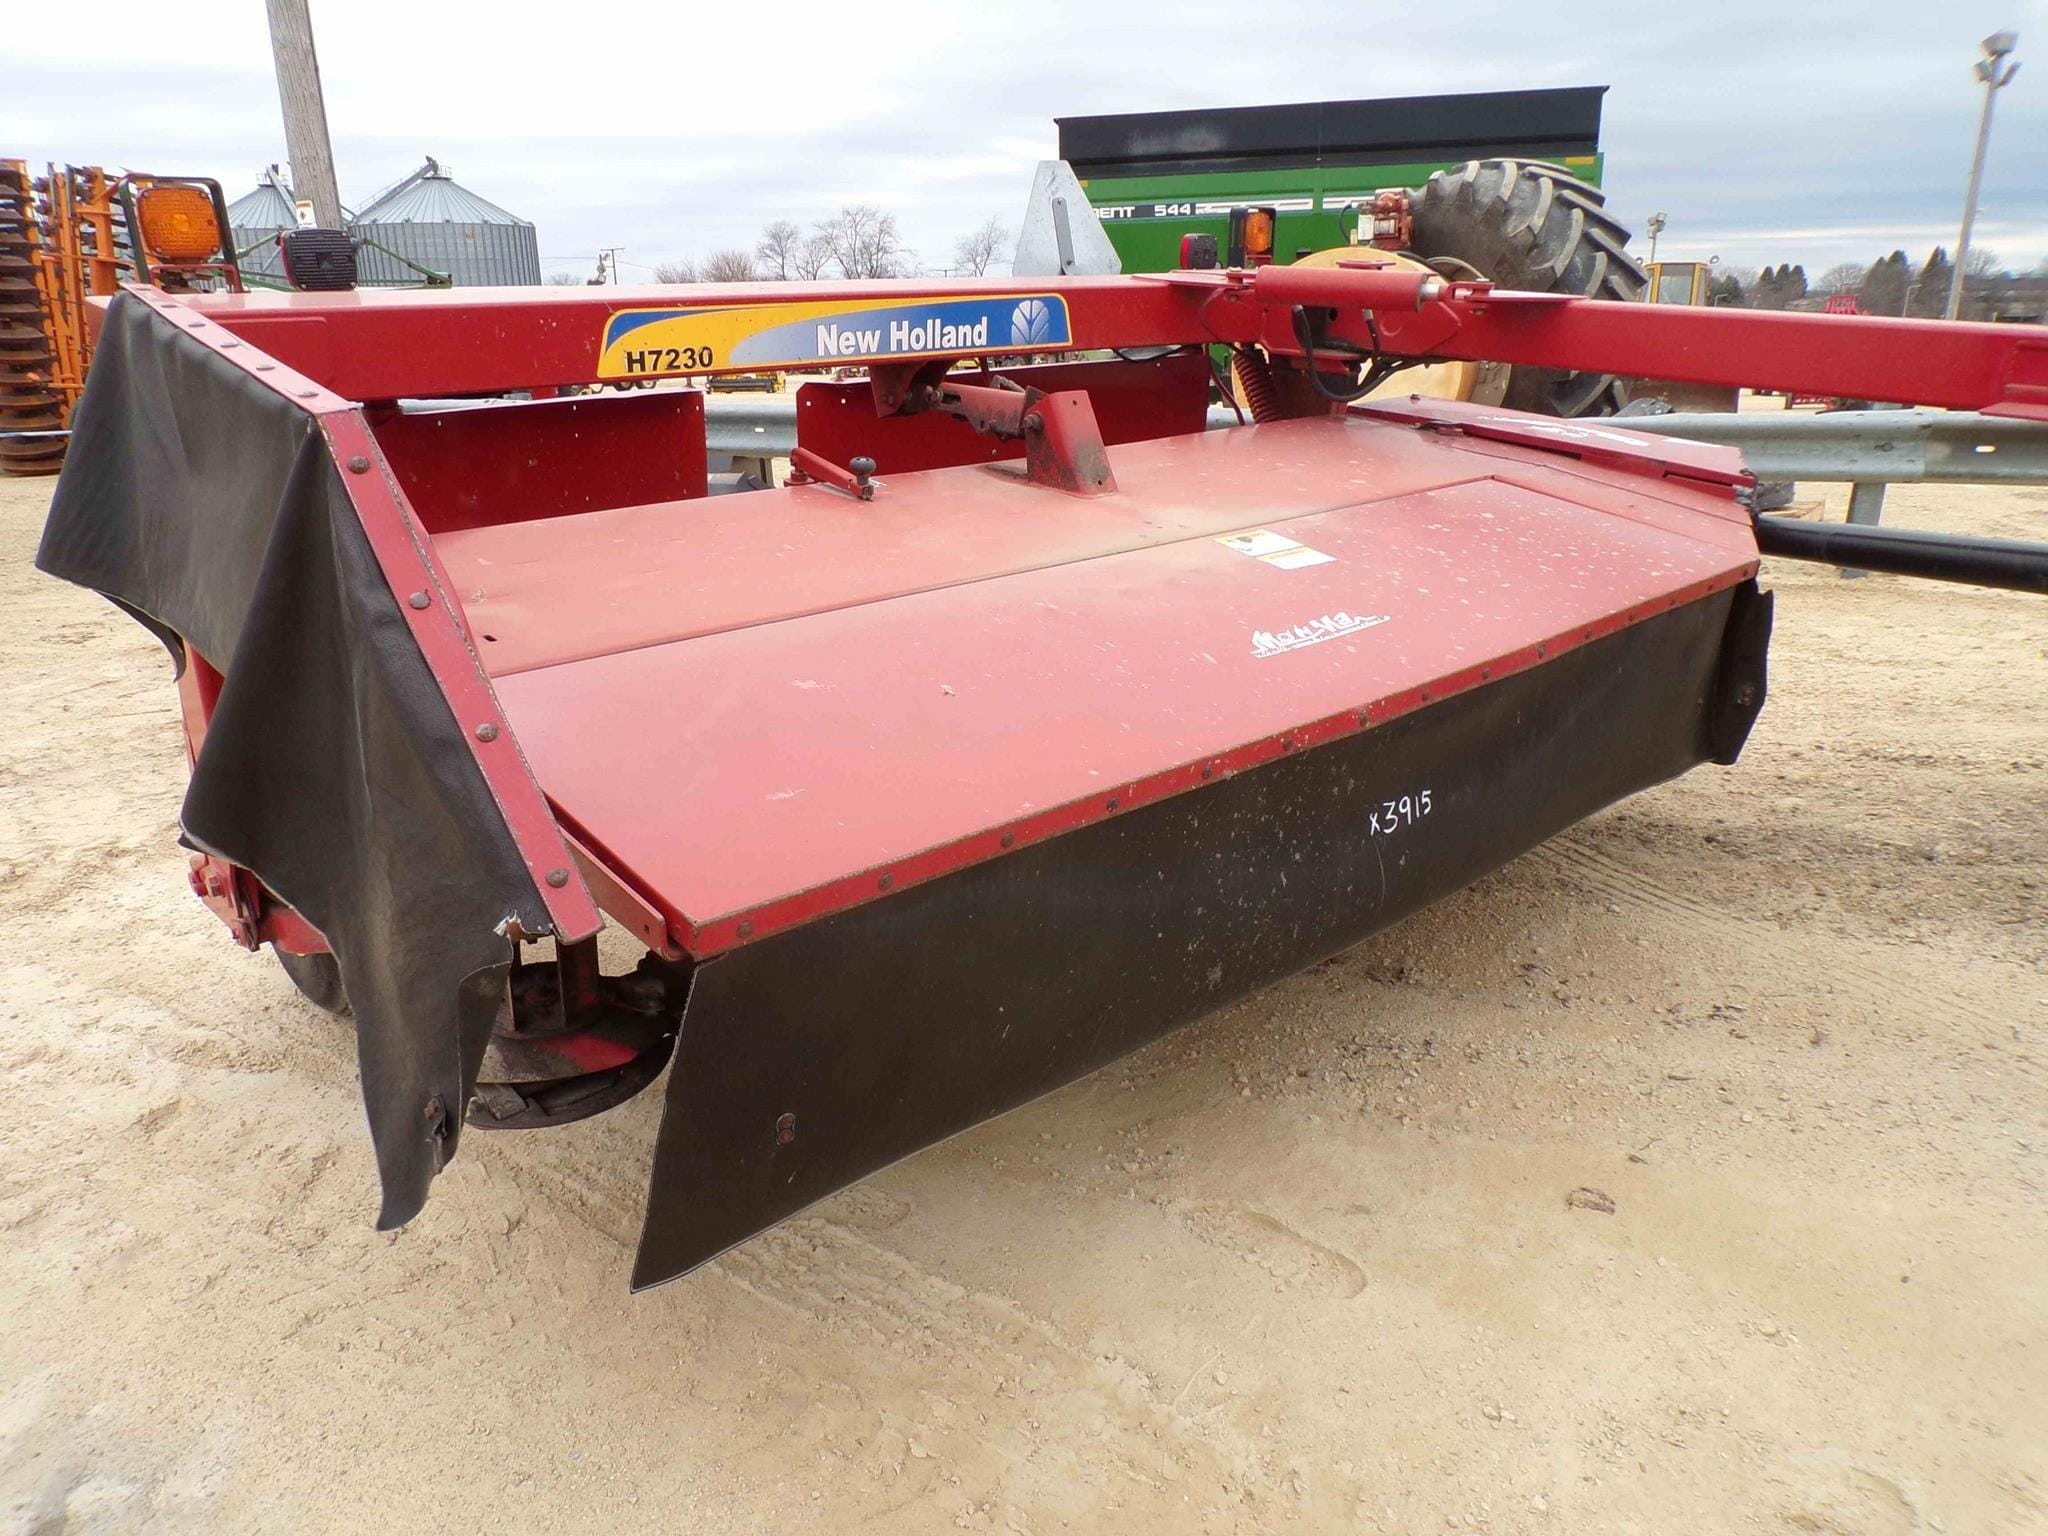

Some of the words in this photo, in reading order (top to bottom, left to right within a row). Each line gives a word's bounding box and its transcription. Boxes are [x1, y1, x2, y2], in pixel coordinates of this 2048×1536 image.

[1092, 206, 1135, 219] RENT
[1154, 203, 1192, 217] 544
[817, 323, 881, 357] New
[890, 316, 988, 352] Holland
[625, 346, 713, 373] H7230
